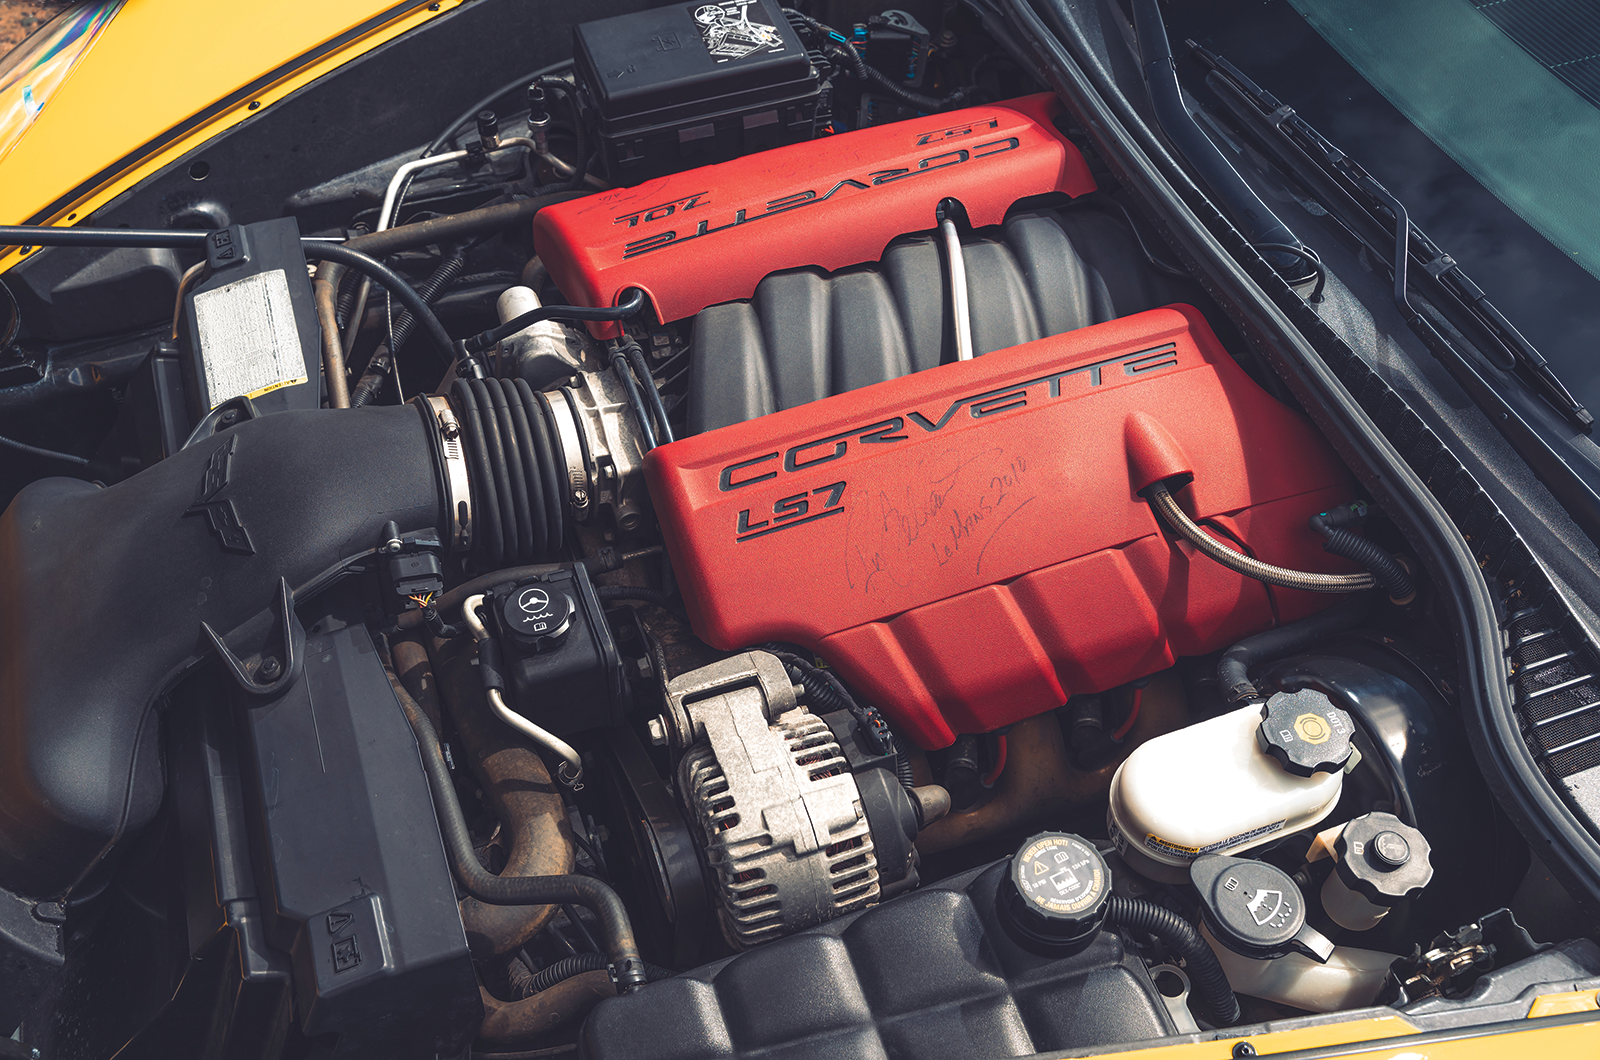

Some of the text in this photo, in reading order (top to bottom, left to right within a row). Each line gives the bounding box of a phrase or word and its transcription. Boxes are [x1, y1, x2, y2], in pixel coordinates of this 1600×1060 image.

[916, 117, 998, 146] LS7
[613, 191, 710, 228] 7.0L
[622, 137, 1019, 260] CORVETTE
[719, 342, 1177, 491] CORVETTE
[736, 481, 847, 543] LS7
[1327, 712, 1342, 728] DOT
[1023, 839, 1069, 863] NEVER OPEN HOT!
[1158, 839, 1198, 852] AVERTISSEMENT
[1071, 859, 1090, 870] 124 kPa
[1038, 878, 1047, 886] PSI
[1035, 895, 1045, 905] NE
[1045, 902, 1071, 911] JAMAIS
[1071, 897, 1091, 910] OUVRIR
